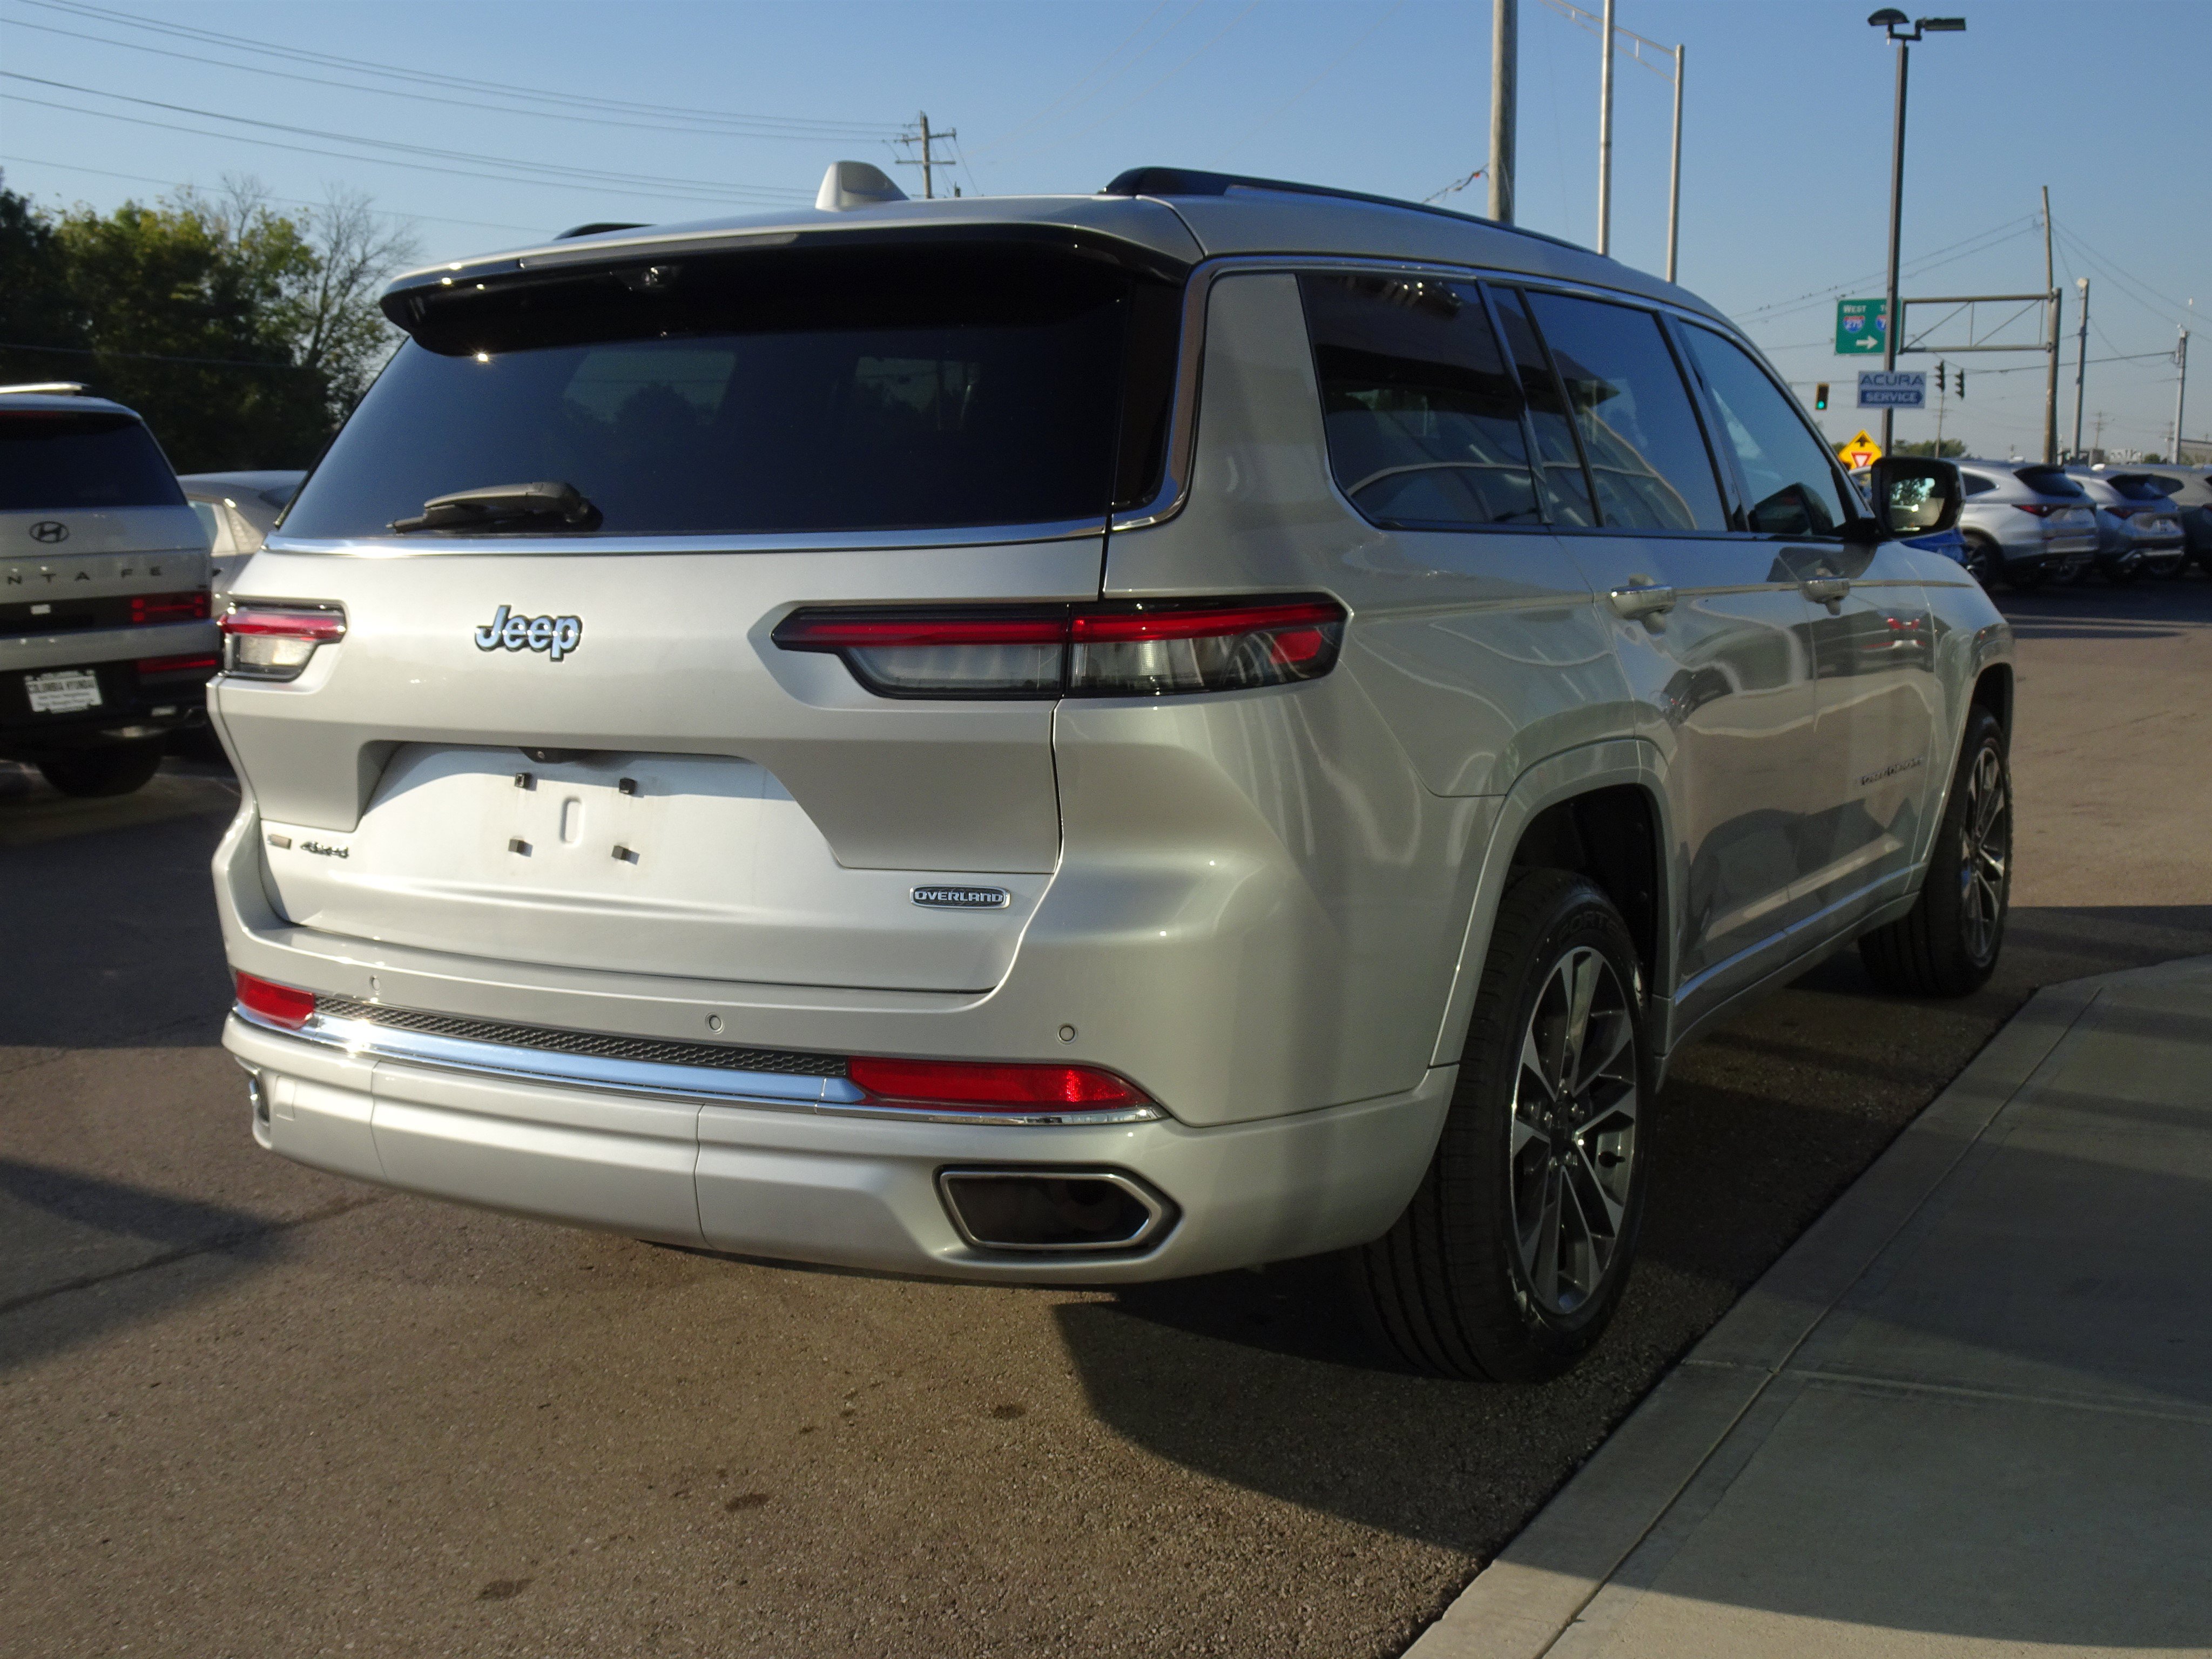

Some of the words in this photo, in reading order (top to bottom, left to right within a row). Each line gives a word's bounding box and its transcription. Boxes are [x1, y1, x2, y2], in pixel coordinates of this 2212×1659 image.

[1861, 374, 1924, 386] ACURA
[1866, 393, 1917, 403] SERVICE
[120, 567, 161, 577] FE
[475, 604, 582, 662] Jeep
[915, 891, 1003, 902] OVERLAND
